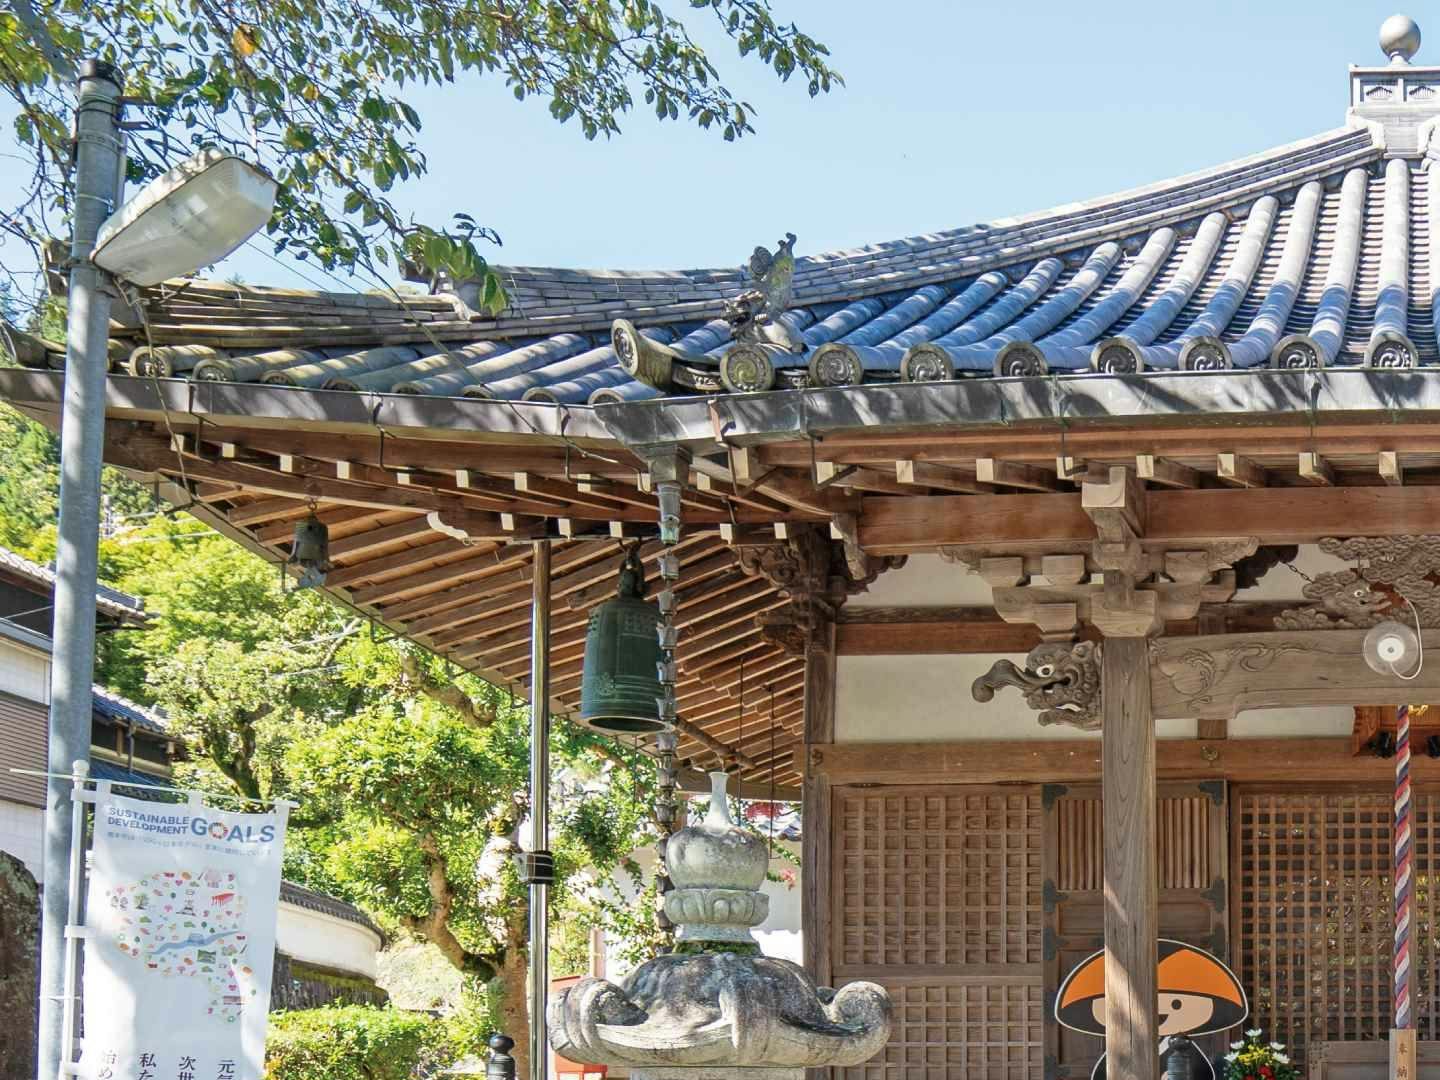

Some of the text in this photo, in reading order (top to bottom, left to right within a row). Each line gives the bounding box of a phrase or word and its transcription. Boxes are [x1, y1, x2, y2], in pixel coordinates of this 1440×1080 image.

[108, 816, 189, 835] DEVELOPMENT
[109, 807, 190, 825] SUSTAINABLE
[191, 817, 275, 843] GOALS
